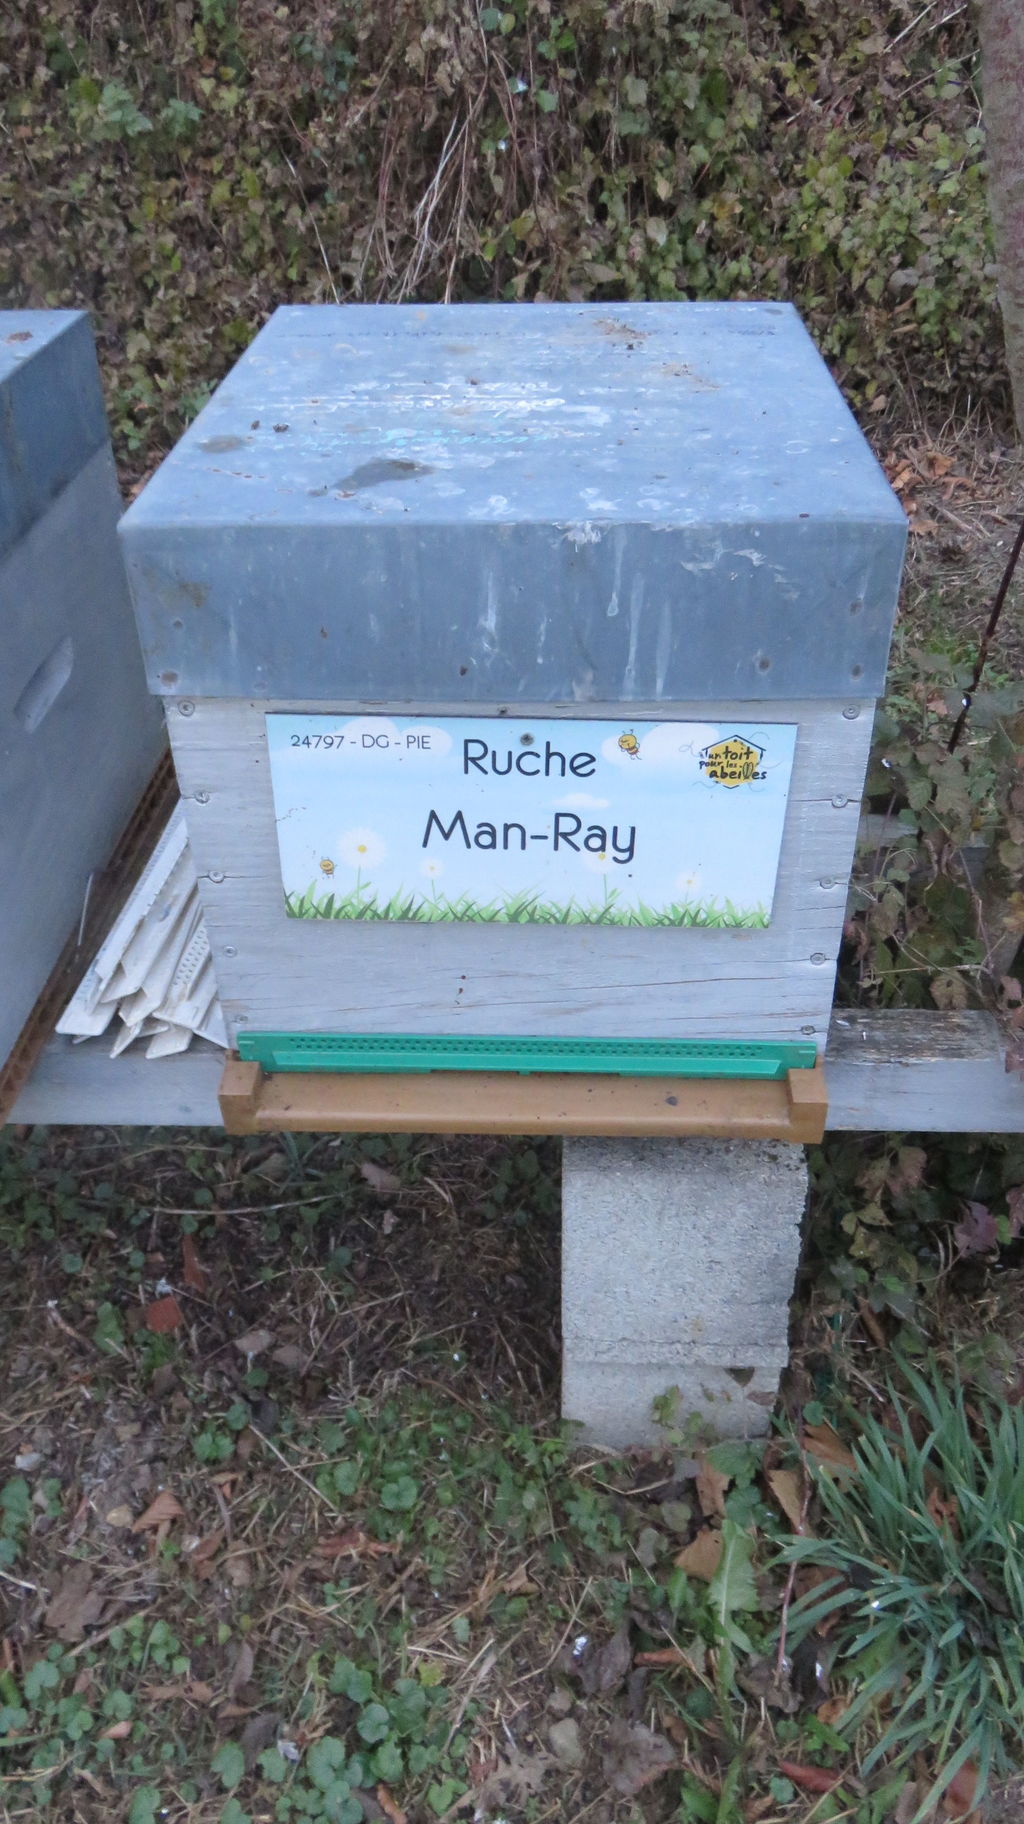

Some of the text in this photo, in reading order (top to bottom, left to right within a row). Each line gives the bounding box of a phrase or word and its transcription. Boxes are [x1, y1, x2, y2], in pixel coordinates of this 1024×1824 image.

[290, 734, 345, 750] 24797
[361, 733, 390, 749] DG
[406, 734, 432, 750] PIE
[463, 738, 597, 778] Ruche
[722, 745, 753, 760] toit
[699, 760, 738, 770] pour les
[709, 761, 767, 780] abeilles
[422, 809, 636, 864] Man-Ray
